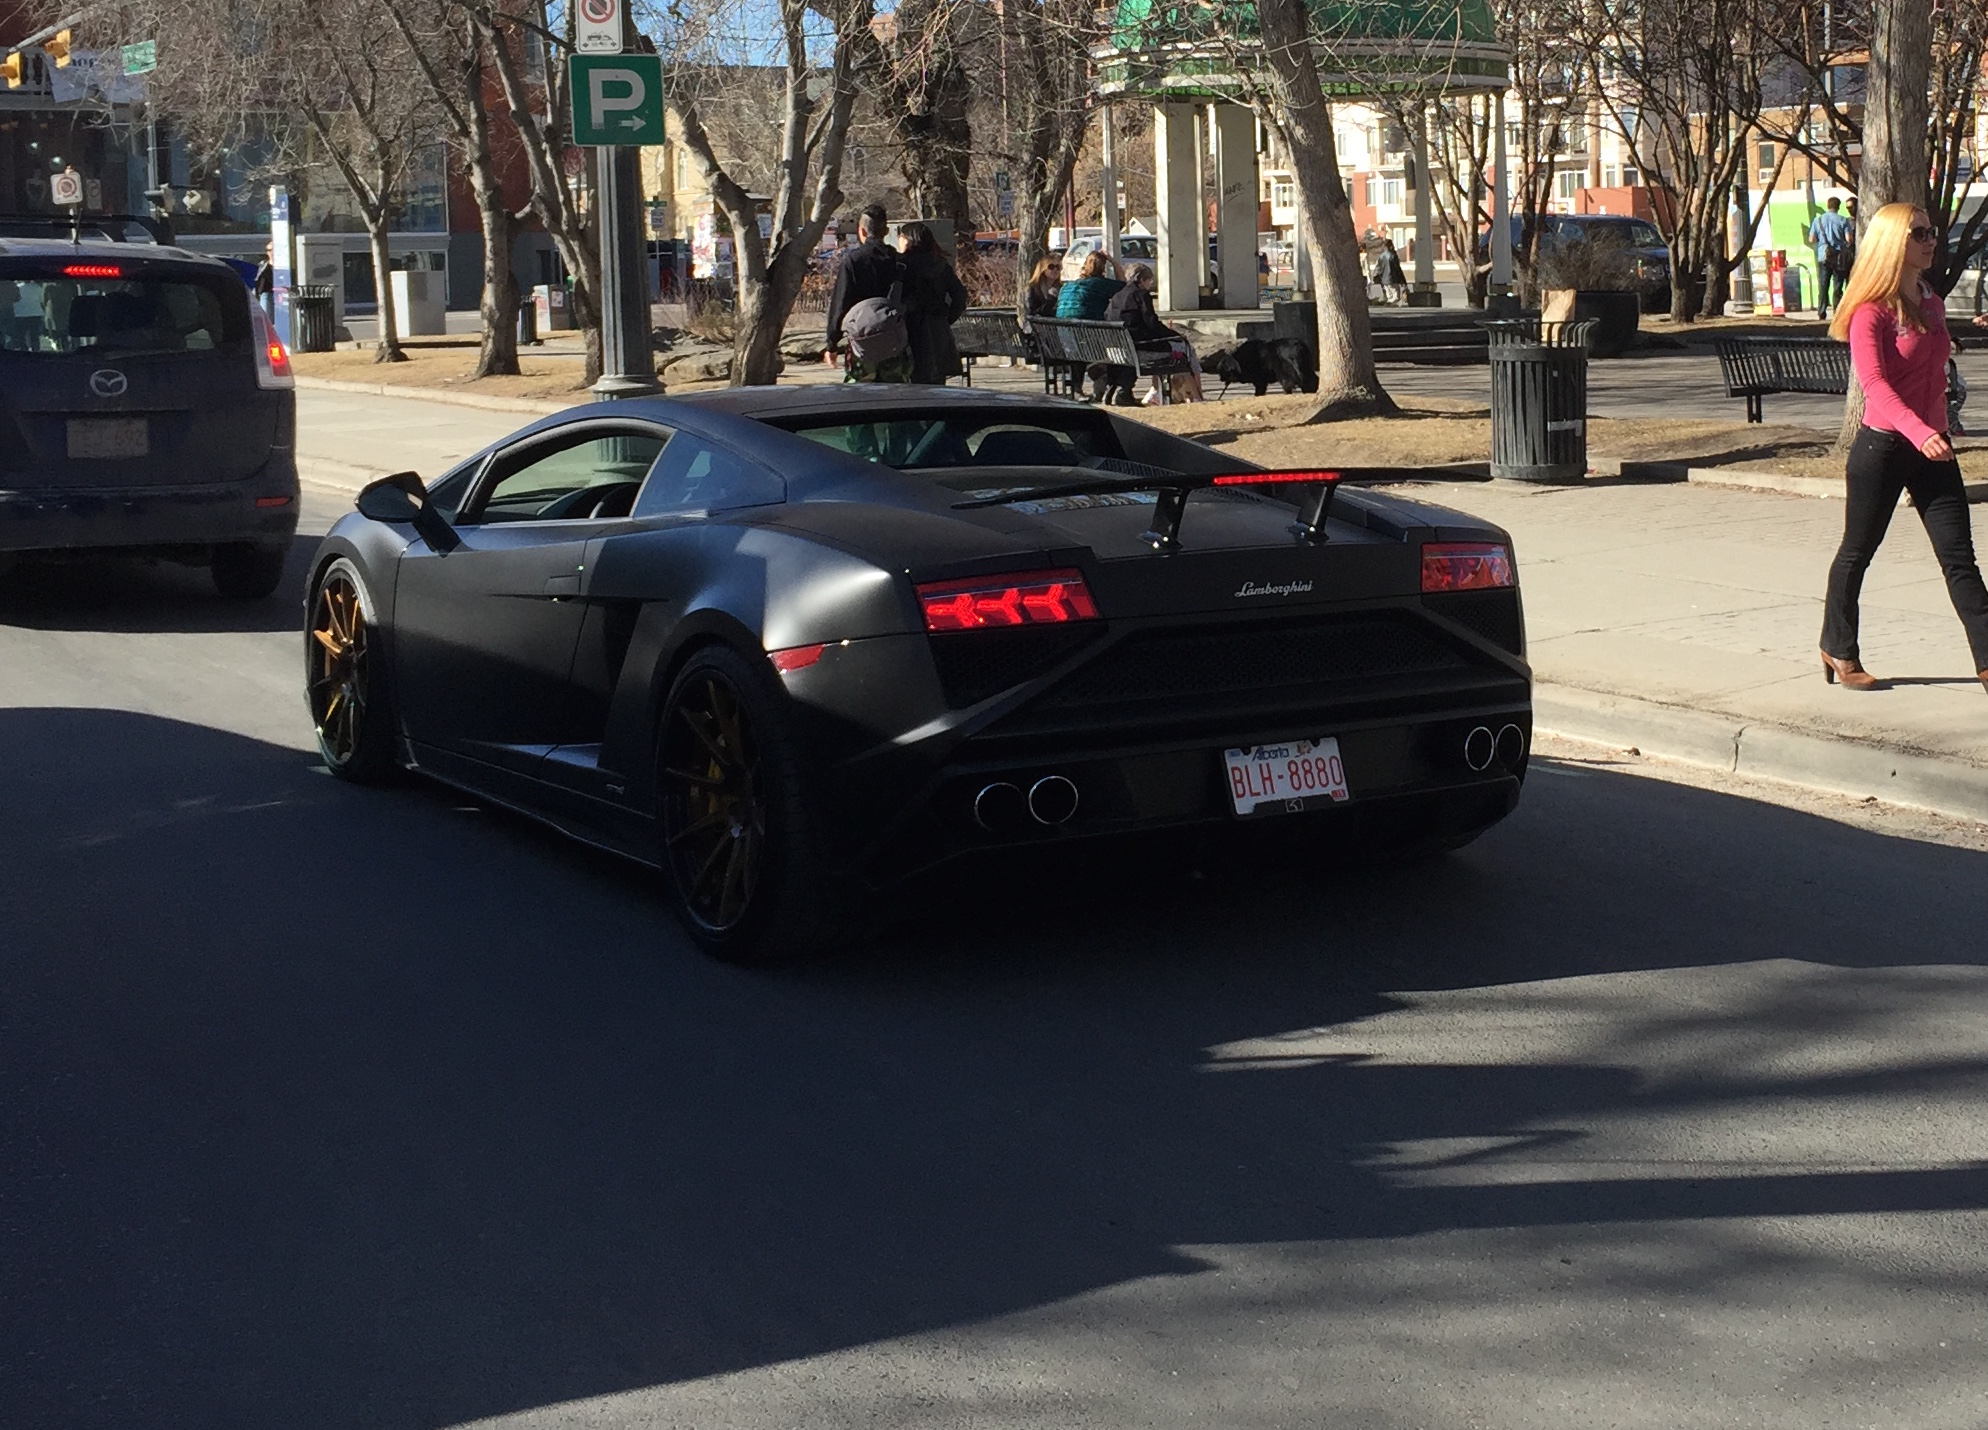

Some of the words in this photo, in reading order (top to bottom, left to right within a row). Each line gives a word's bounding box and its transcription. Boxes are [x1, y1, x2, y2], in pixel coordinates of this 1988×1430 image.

[588, 68, 646, 130] P
[1234, 579, 1314, 598] Lamborghini
[1251, 746, 1290, 762] Alberta
[1230, 755, 1344, 799] BLH-8880
